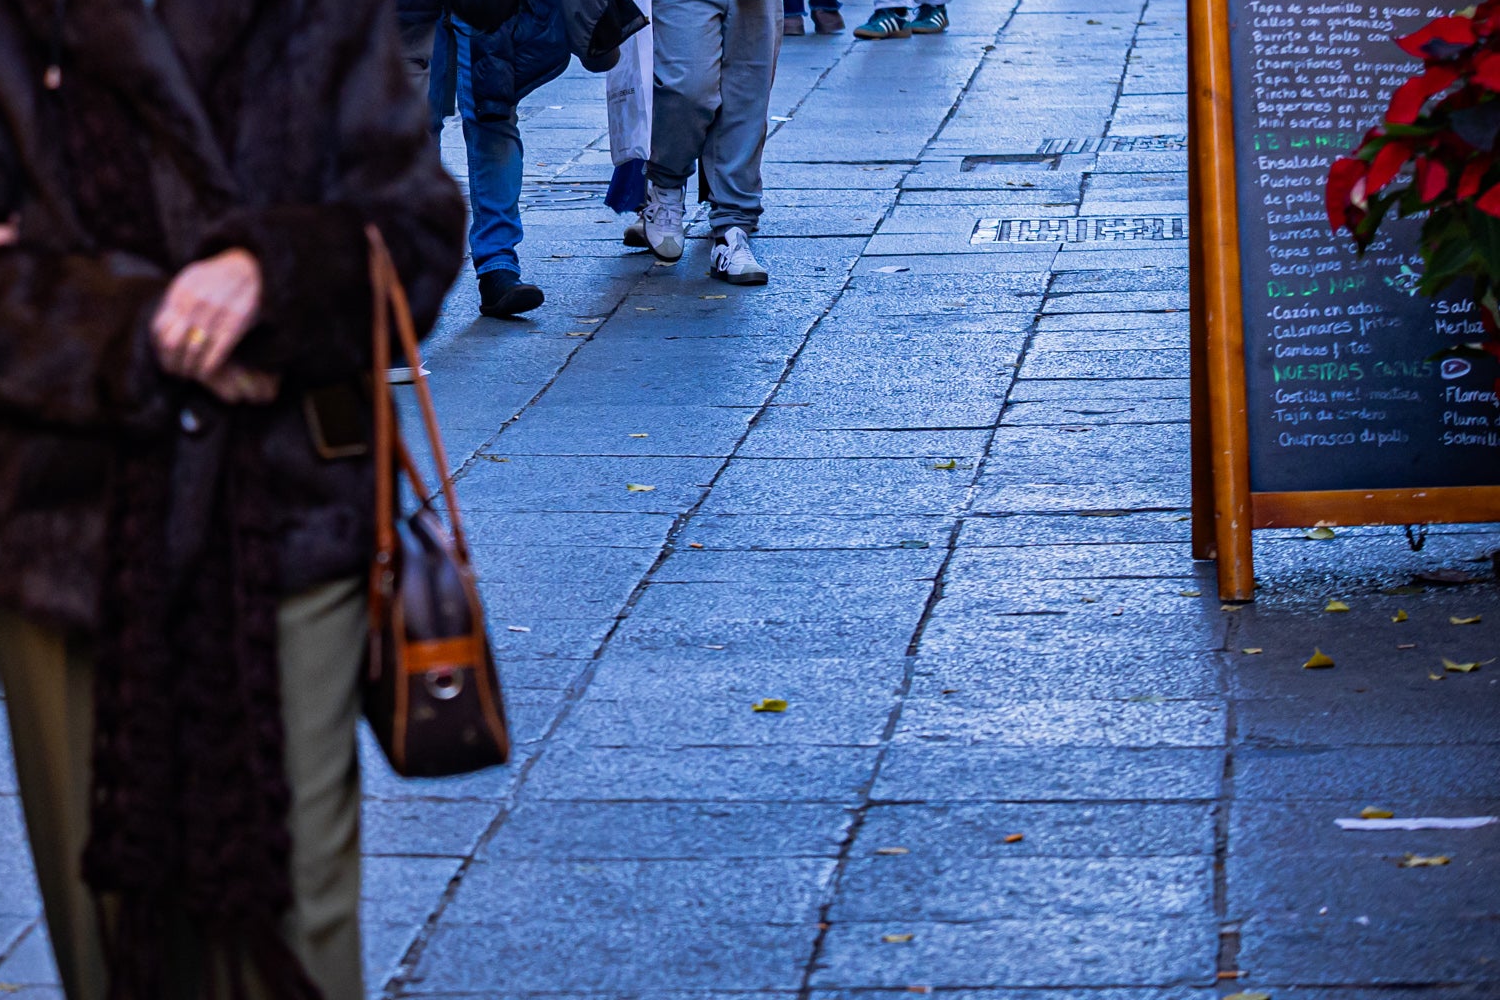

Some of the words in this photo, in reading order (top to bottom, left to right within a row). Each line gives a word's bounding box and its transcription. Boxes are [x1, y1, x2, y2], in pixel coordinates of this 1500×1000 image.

[1249, 1, 1283, 16] Tapa
[1287, 3, 1303, 15] de
[1368, 5, 1378, 19] y
[1382, 6, 1421, 20] queso
[1253, 16, 1295, 28] Callos
[1300, 17, 1321, 27] con
[1252, 28, 1302, 42] Burrito
[1308, 30, 1326, 42] de
[1328, 29, 1361, 47] pollo
[1367, 32, 1390, 42] con
[1253, 42, 1310, 56] Patatas
[1253, 71, 1290, 87] Tapa
[1295, 74, 1310, 85] de
[1314, 70, 1352, 85] cazón
[1254, 86, 1298, 100] Pincho
[1300, 87, 1316, 98] de
[1257, 101, 1333, 118] Boquerones
[1337, 104, 1356, 114] en
[1258, 115, 1286, 129] Mini
[1258, 155, 1330, 170] Ensalada
[1260, 173, 1311, 188] Puchero
[1263, 193, 1282, 206] de
[1267, 208, 1330, 225] Ensalada
[1269, 227, 1321, 242] burrata
[1268, 244, 1310, 260] Papas
[1316, 245, 1339, 256] con
[1269, 260, 1342, 278] Berenjenas
[1273, 302, 1321, 320] Cazón
[1323, 305, 1344, 317] en
[1273, 320, 1353, 340] Calamares
[1272, 361, 1364, 384] NUESTRAS
[1275, 387, 1328, 404] Costilla
[1443, 410, 1489, 427] Pluma
[1278, 431, 1356, 448] Churrasco
